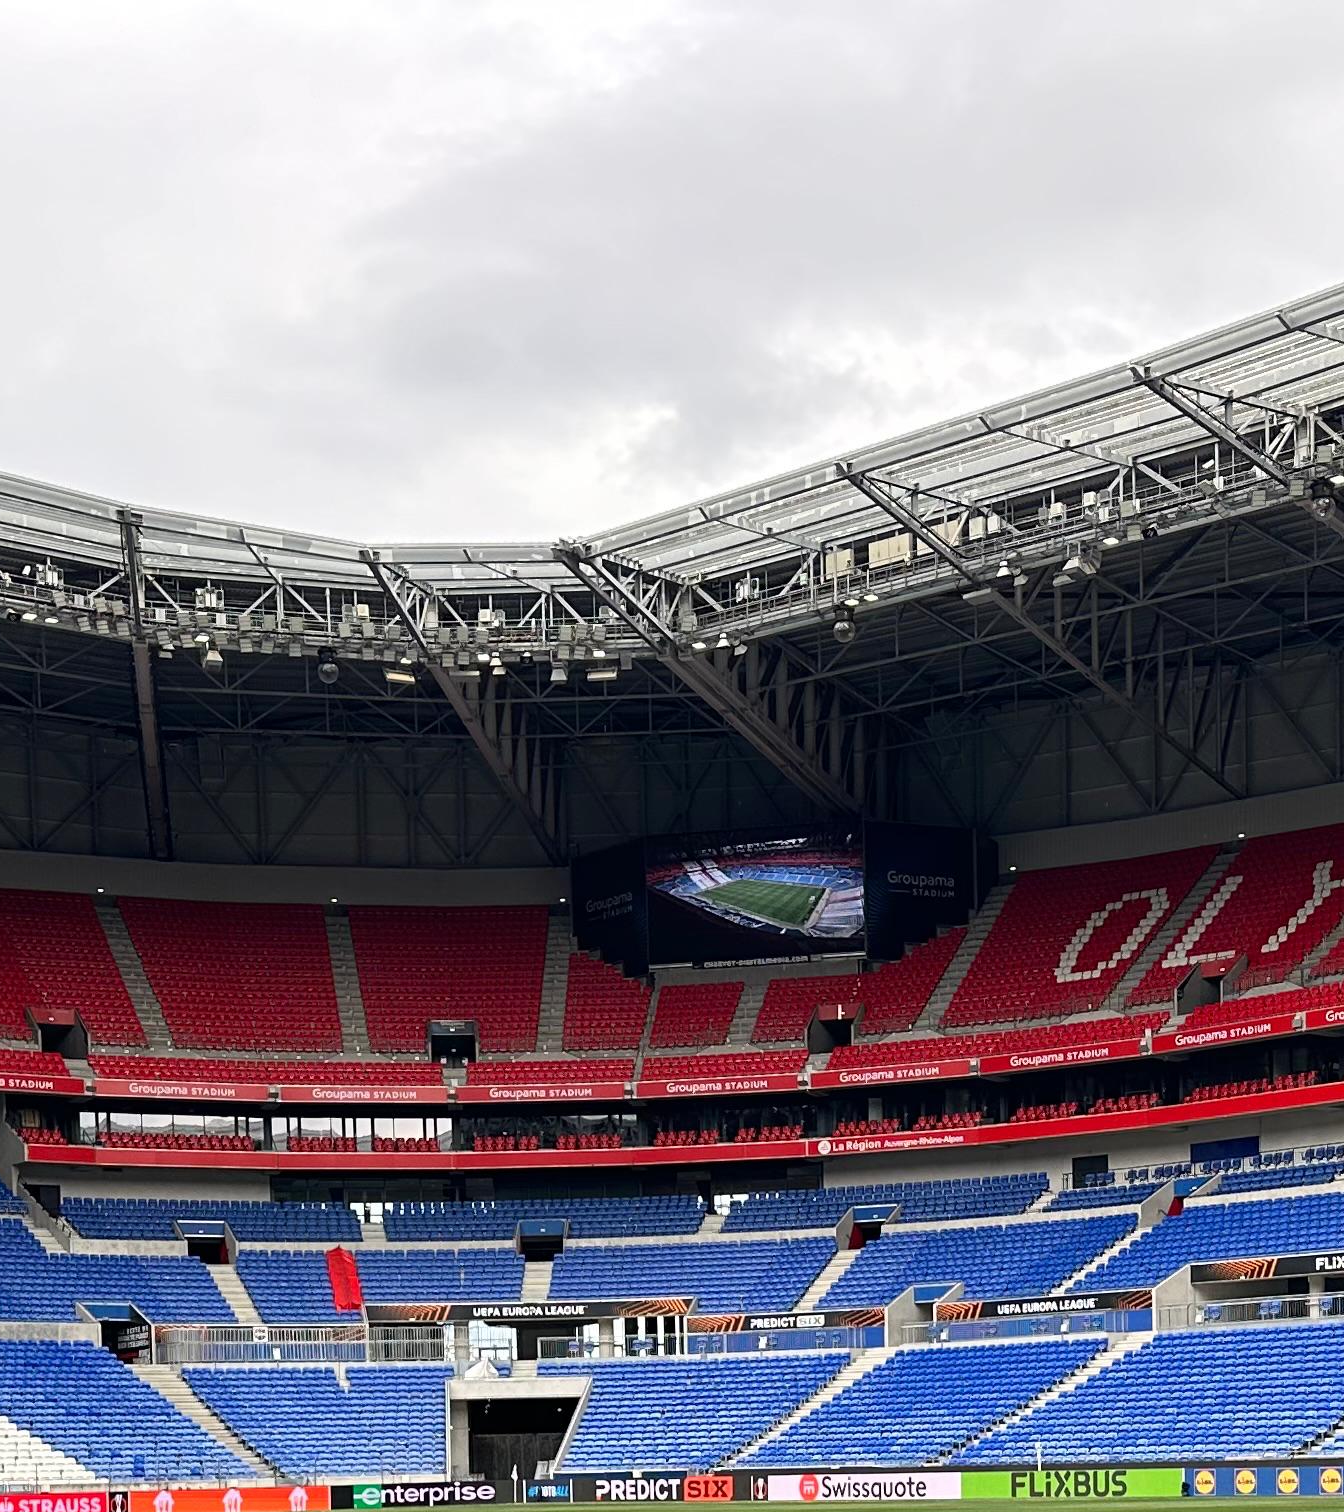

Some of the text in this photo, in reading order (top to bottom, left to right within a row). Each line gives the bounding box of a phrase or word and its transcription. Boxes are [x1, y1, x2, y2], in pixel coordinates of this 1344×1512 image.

[887, 870, 955, 888] Groupama
[912, 888, 955, 898] STADIUM
[1174, 1022, 1271, 1047] Groupama STADIUM
[1009, 1047, 1109, 1068] Groupama STADIUM
[839, 1066, 940, 1084] Groupama STADIUM
[8, 1078, 54, 1090] STADIUM
[128, 1082, 236, 1098] Groupama STADIUM
[666, 1079, 768, 1094] Groupama STADIUM
[312, 1087, 417, 1101] Groupama STADIUM
[489, 1087, 592, 1101] Groupama STADIUM
[472, 1306, 501, 1317] UEFA
[502, 1306, 543, 1317] EUROPA
[997, 1303, 1021, 1316] UEFA
[1022, 1301, 1058, 1313] EUROPA
[750, 1315, 796, 1328] PREDICT
[353, 1482, 496, 1507] enterprise
[595, 1479, 728, 1501] PREDICT SIX
[822, 1476, 927, 1500] Swissquote
